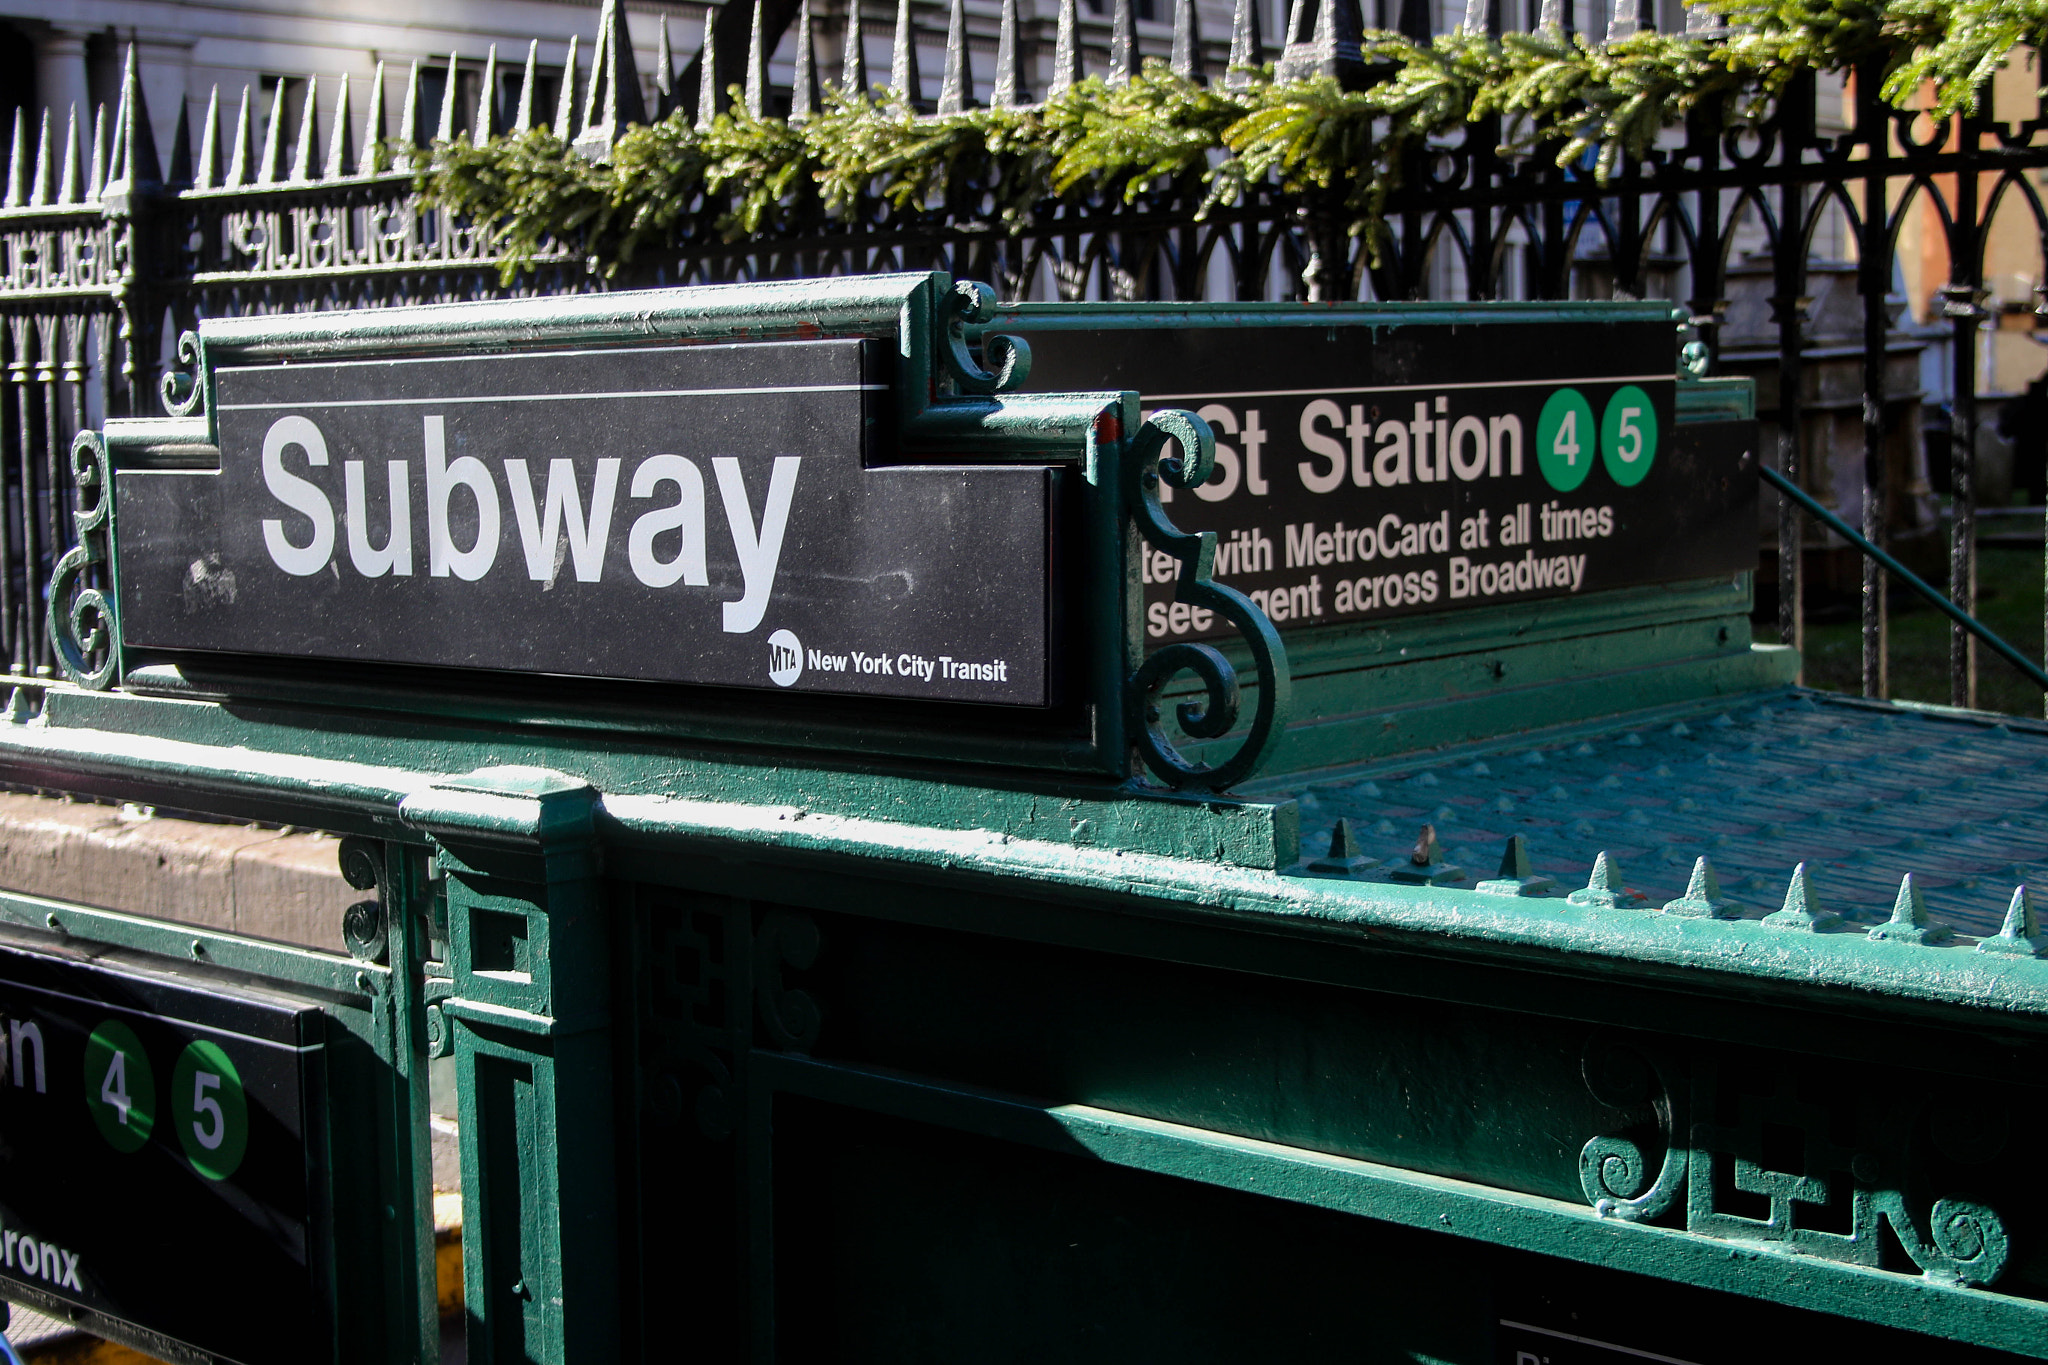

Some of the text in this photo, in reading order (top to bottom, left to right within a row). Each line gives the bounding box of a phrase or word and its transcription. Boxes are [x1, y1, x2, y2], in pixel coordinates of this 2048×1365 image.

[1192, 403, 1269, 502] St
[1298, 396, 1523, 494] Station
[1553, 410, 1580, 466] 4
[1617, 407, 1642, 463] 5
[262, 414, 802, 633] Subway
[1212, 527, 1273, 577] with
[1285, 511, 1449, 568] MetroCard
[1460, 509, 1489, 550] at
[1500, 503, 1530, 546] all
[1540, 500, 1614, 542] times
[1147, 601, 1214, 637] see
[1335, 571, 1438, 613] across
[1450, 549, 1586, 599] Broadway
[808, 649, 848, 672] New
[851, 651, 893, 675] York
[897, 654, 935, 682] City
[939, 656, 1007, 682] Transit
[101, 1050, 132, 1126] 4
[192, 1070, 225, 1149] 5
[0, 1227, 82, 1292] ronx
